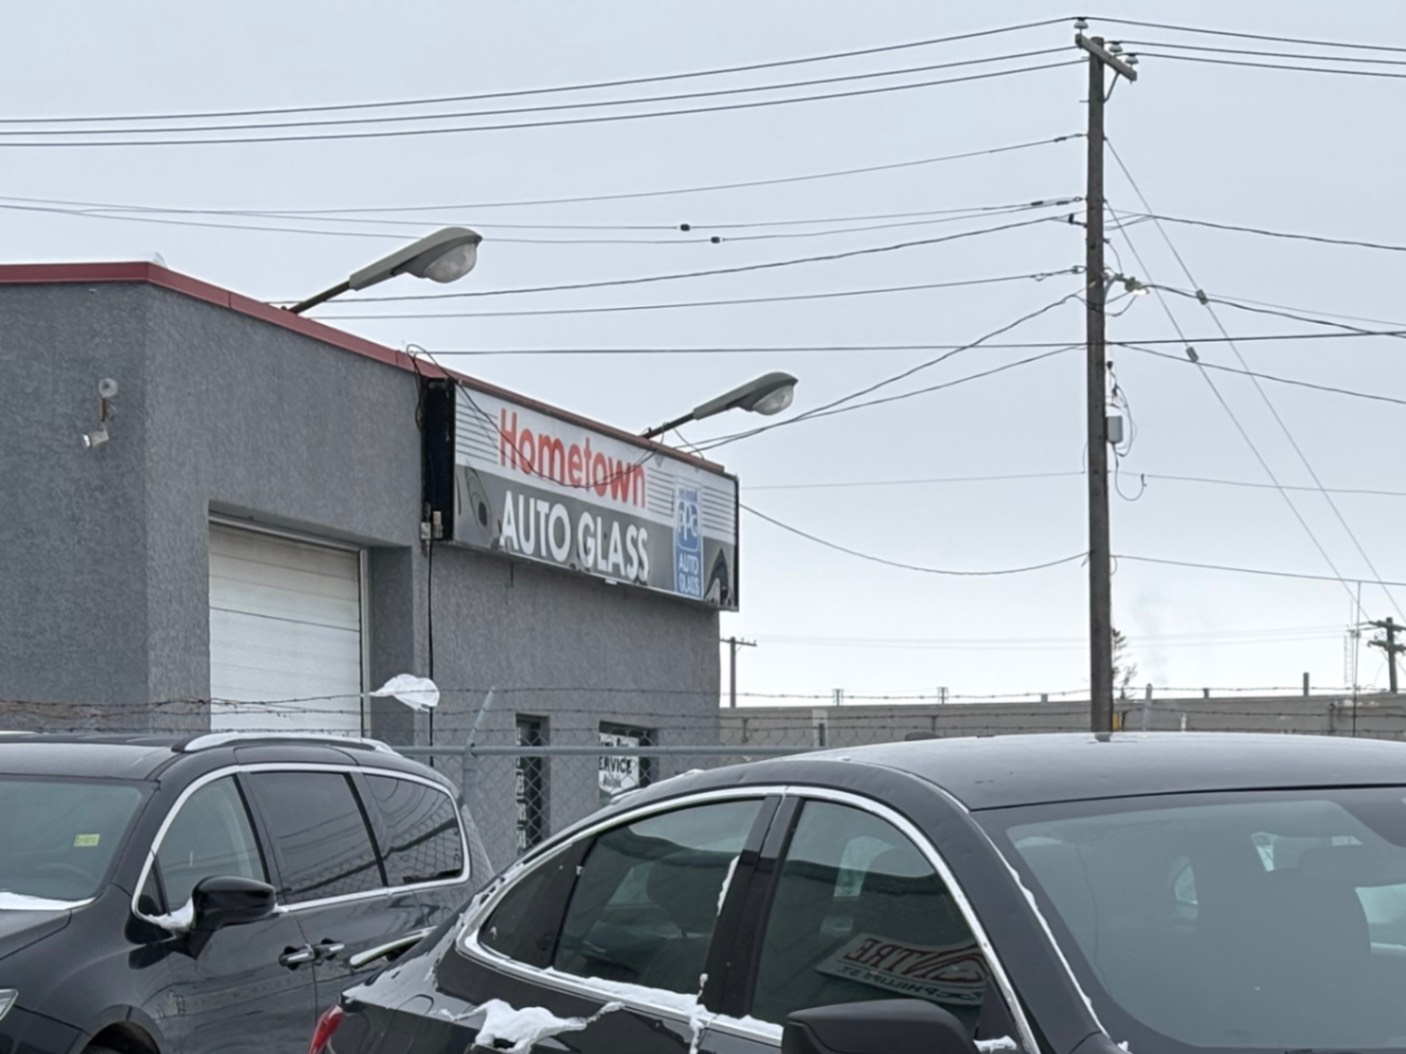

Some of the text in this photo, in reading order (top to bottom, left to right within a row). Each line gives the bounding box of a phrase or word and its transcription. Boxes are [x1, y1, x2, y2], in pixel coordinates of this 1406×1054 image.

[501, 408, 647, 507] Hometown
[500, 490, 649, 583] AUTO GLASS
[679, 552, 699, 575] AUTO
[679, 573, 699, 597] GLASS
[599, 755, 632, 775] ERVICE
